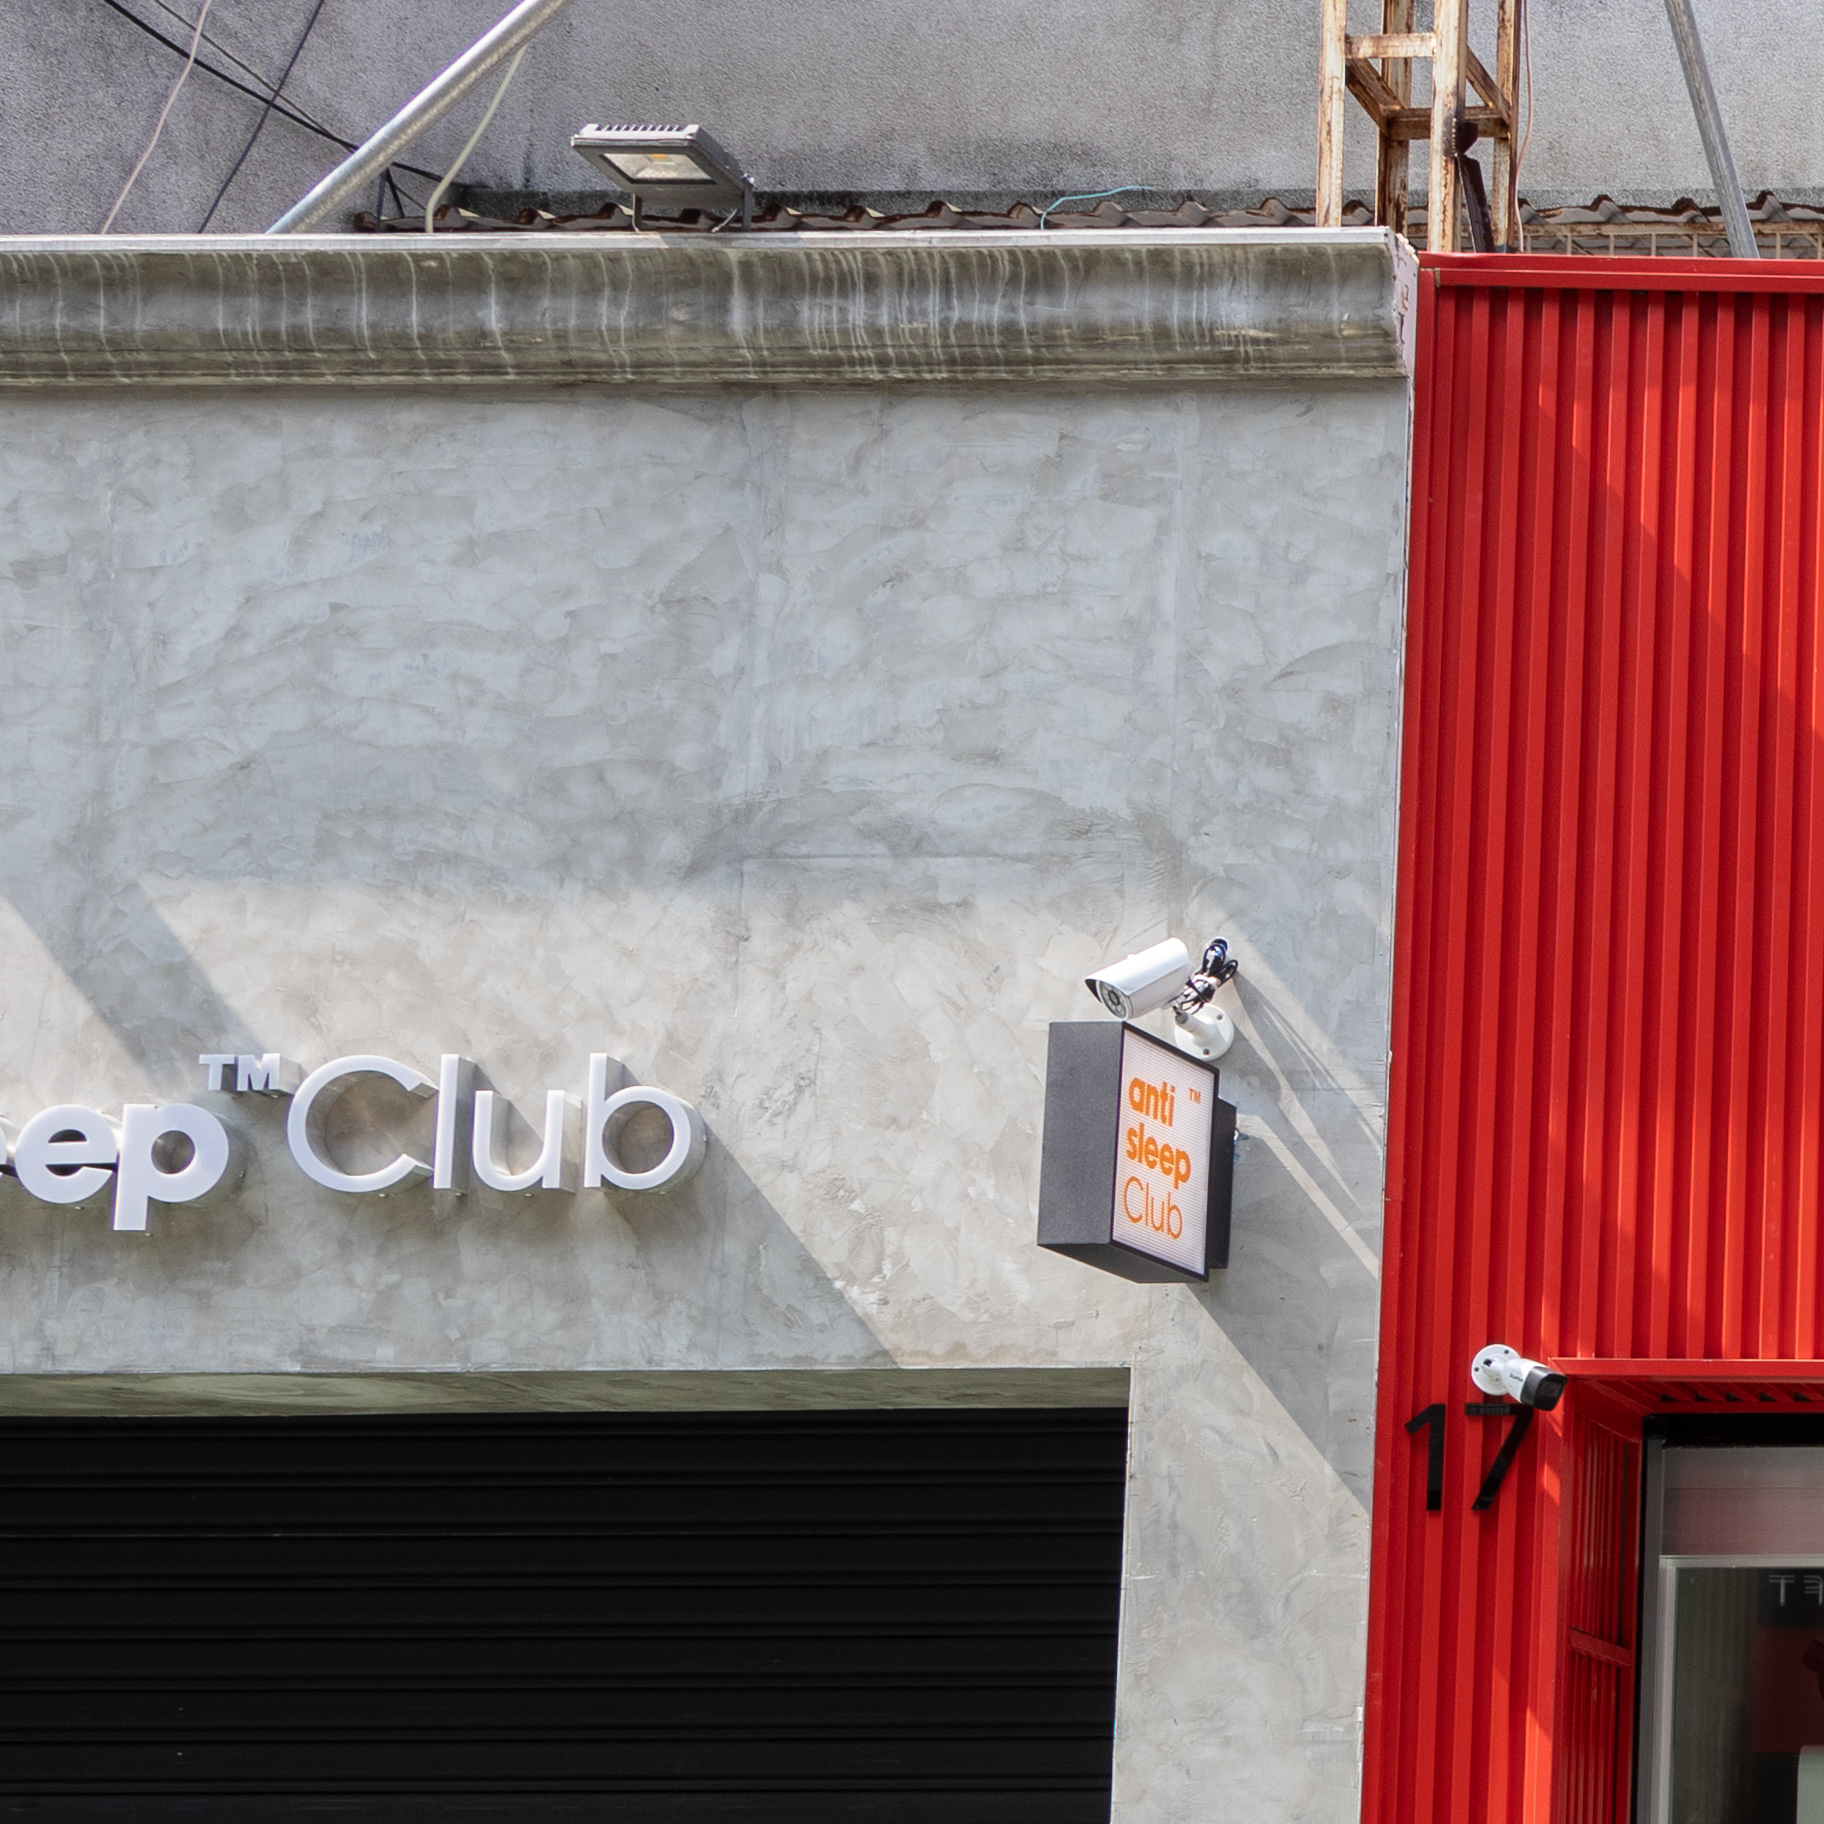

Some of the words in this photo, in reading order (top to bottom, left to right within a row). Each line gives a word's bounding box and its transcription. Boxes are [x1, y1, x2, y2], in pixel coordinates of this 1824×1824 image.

[1128, 1077, 1176, 1127] anti
[0, 1101, 230, 1231] ep
[287, 1053, 690, 1194] Club
[1125, 1122, 1192, 1190] sleep
[1123, 1176, 1183, 1239] Club
[1404, 1402, 1534, 1512] 17
